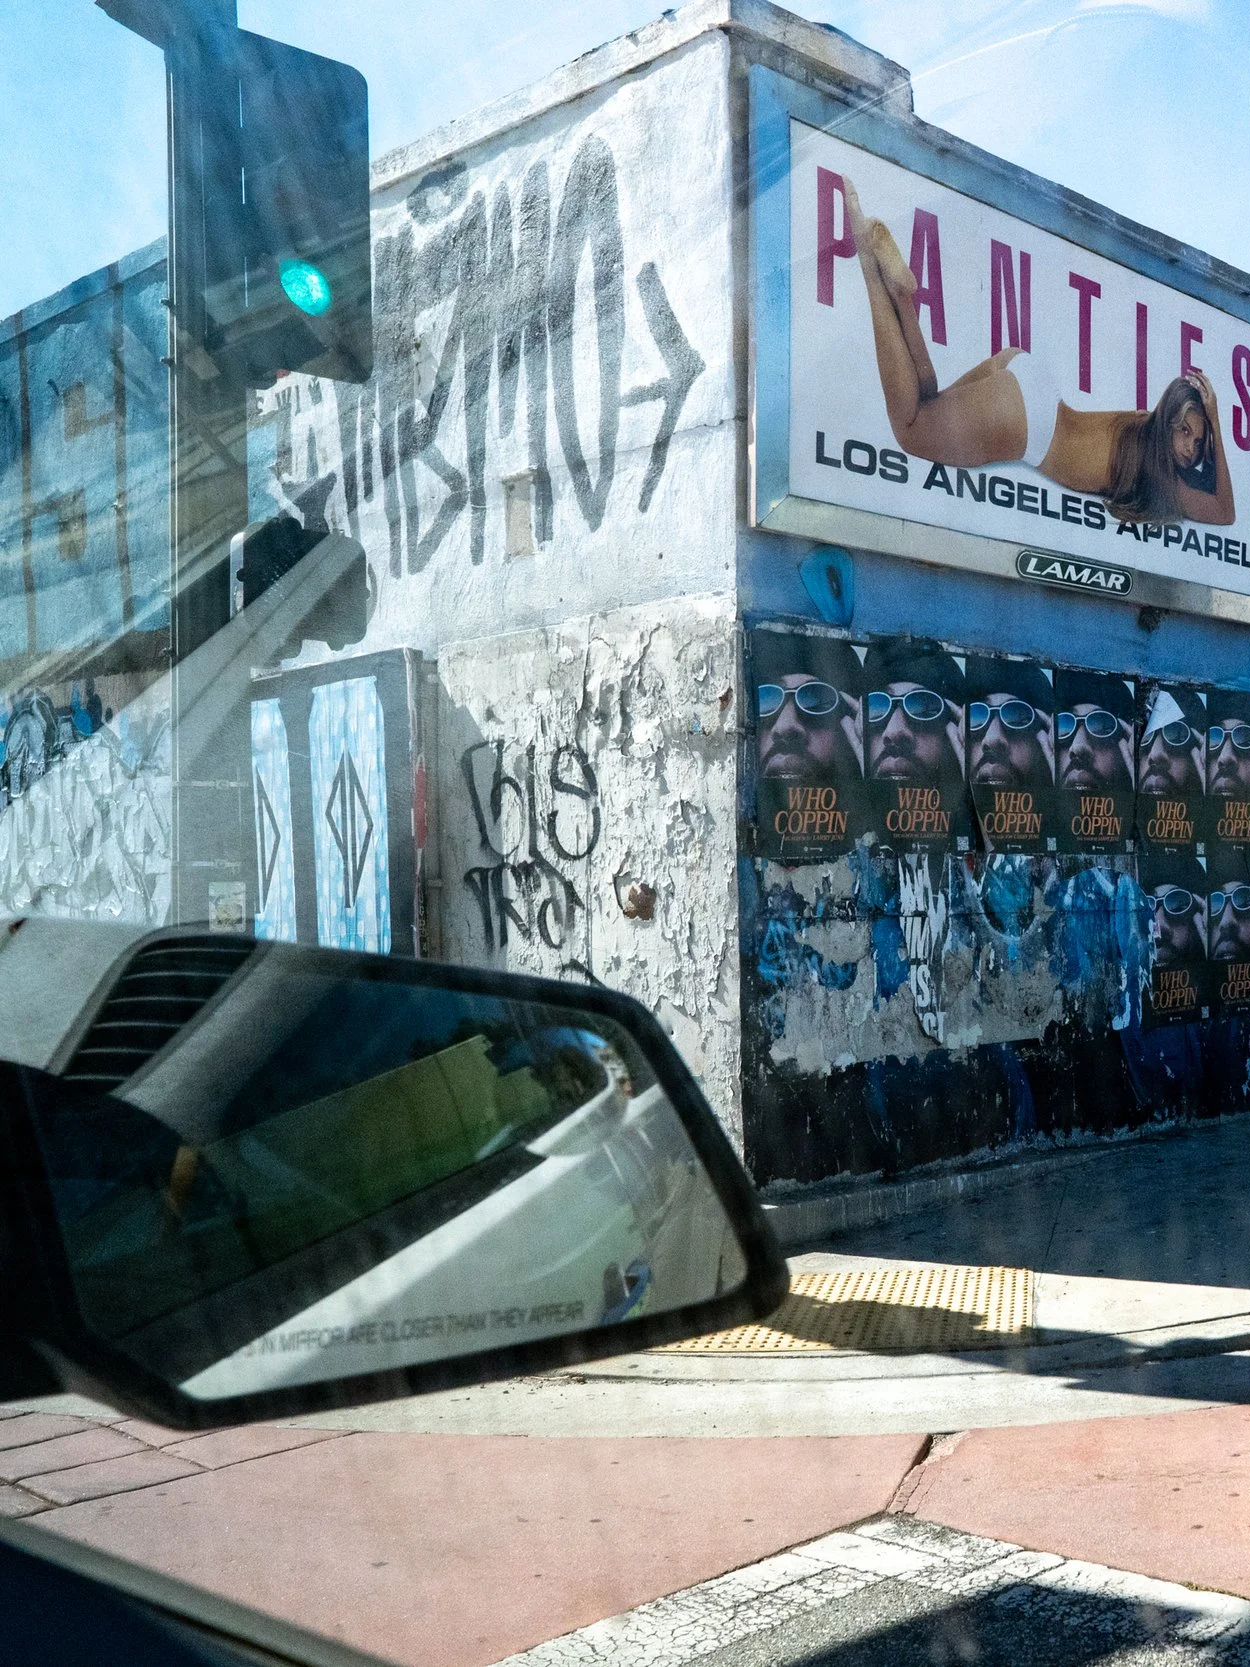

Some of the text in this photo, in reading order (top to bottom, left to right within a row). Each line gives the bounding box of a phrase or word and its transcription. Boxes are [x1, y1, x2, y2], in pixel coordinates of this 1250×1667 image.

[815, 431, 909, 485] LOS
[922, 462, 1107, 532] ANGELES
[1025, 556, 1127, 590] LAMAR
[788, 787, 837, 810] WHO
[898, 787, 940, 811] WHO
[994, 792, 1033, 813] WHO
[1080, 796, 1114, 816] WHO
[887, 809, 950, 832] COPPIN
[1156, 801, 1186, 820] WHO
[774, 810, 848, 834] COPPIN
[983, 812, 1042, 833] COPPIN
[1071, 816, 1122, 836] COPPIN
[1147, 819, 1194, 839] COPPIN
[1160, 969, 1190, 990] WHO
[1151, 986, 1198, 1010] COPPIN
